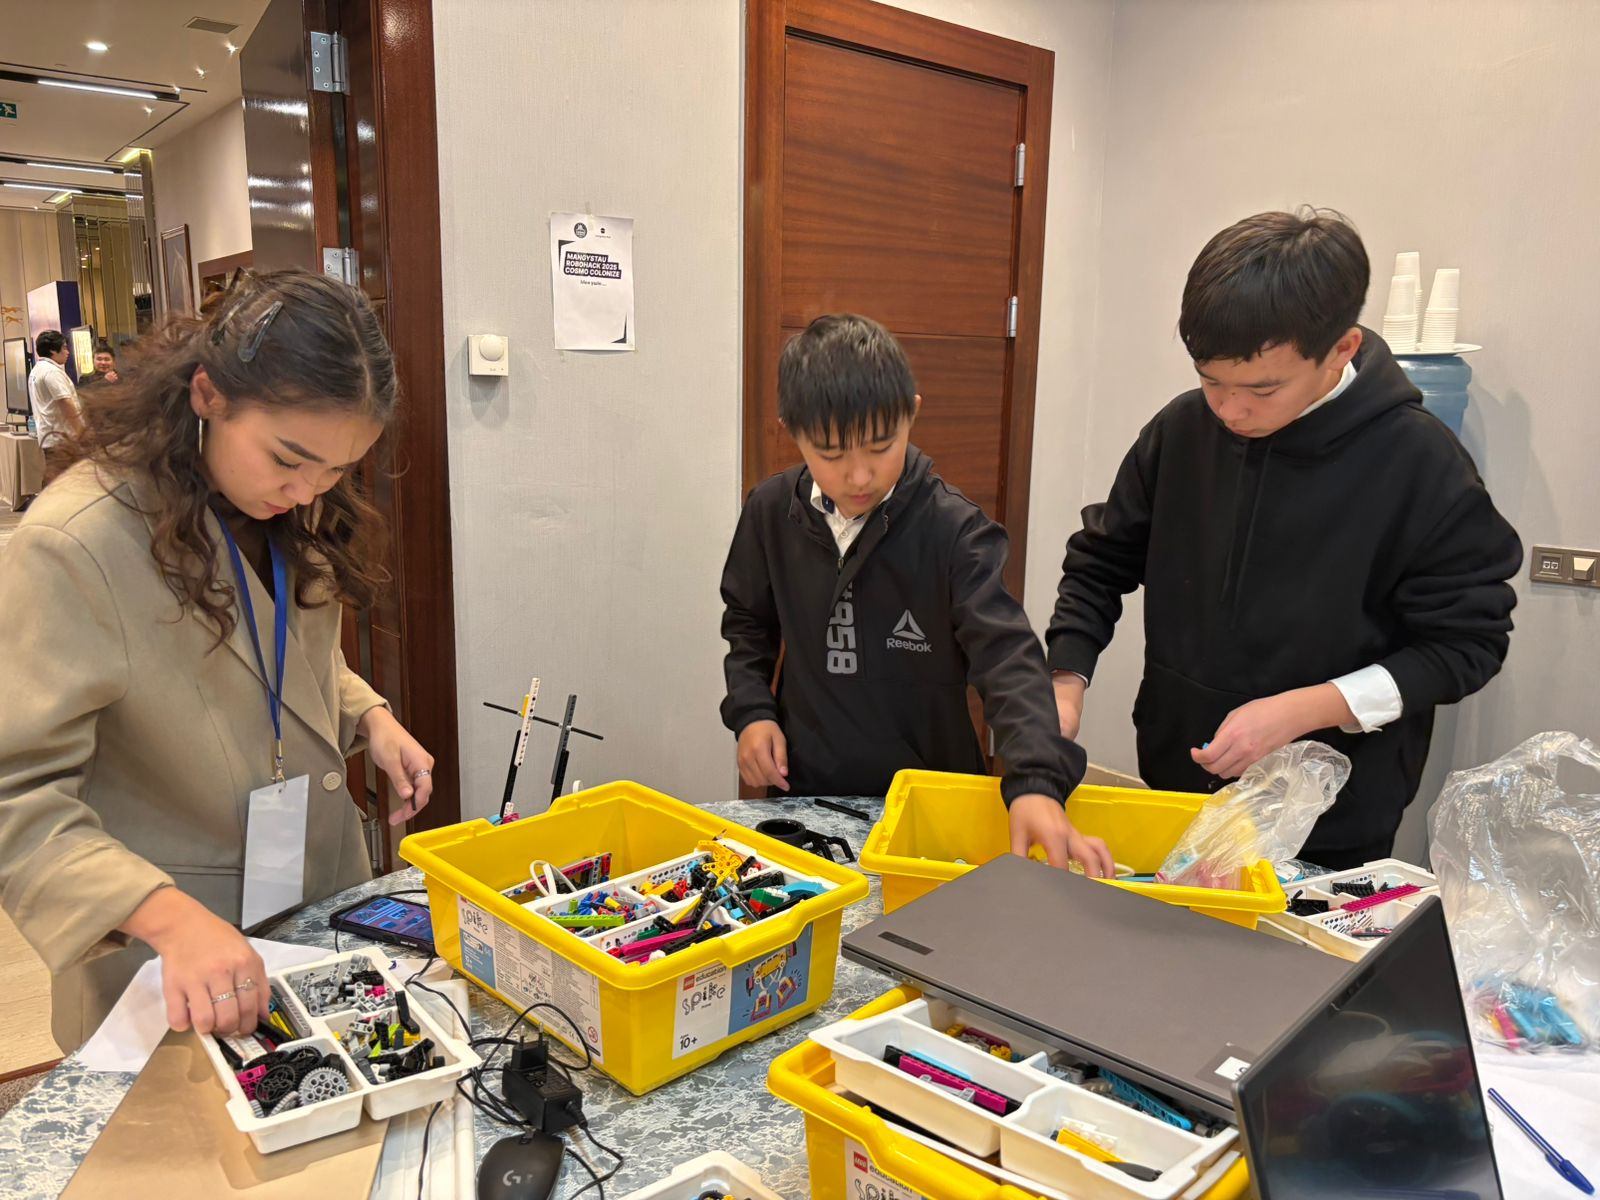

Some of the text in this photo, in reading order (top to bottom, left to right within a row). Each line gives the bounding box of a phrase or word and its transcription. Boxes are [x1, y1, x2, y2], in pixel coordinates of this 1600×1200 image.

[566, 253, 607, 262] MANGYSTAU
[566, 260, 601, 269] ROBOHACK
[565, 267, 620, 277] COSMO COLONIZE
[886, 637, 933, 653] Reebok
[695, 965, 727, 982] education
[680, 1037, 698, 1050] 10+
